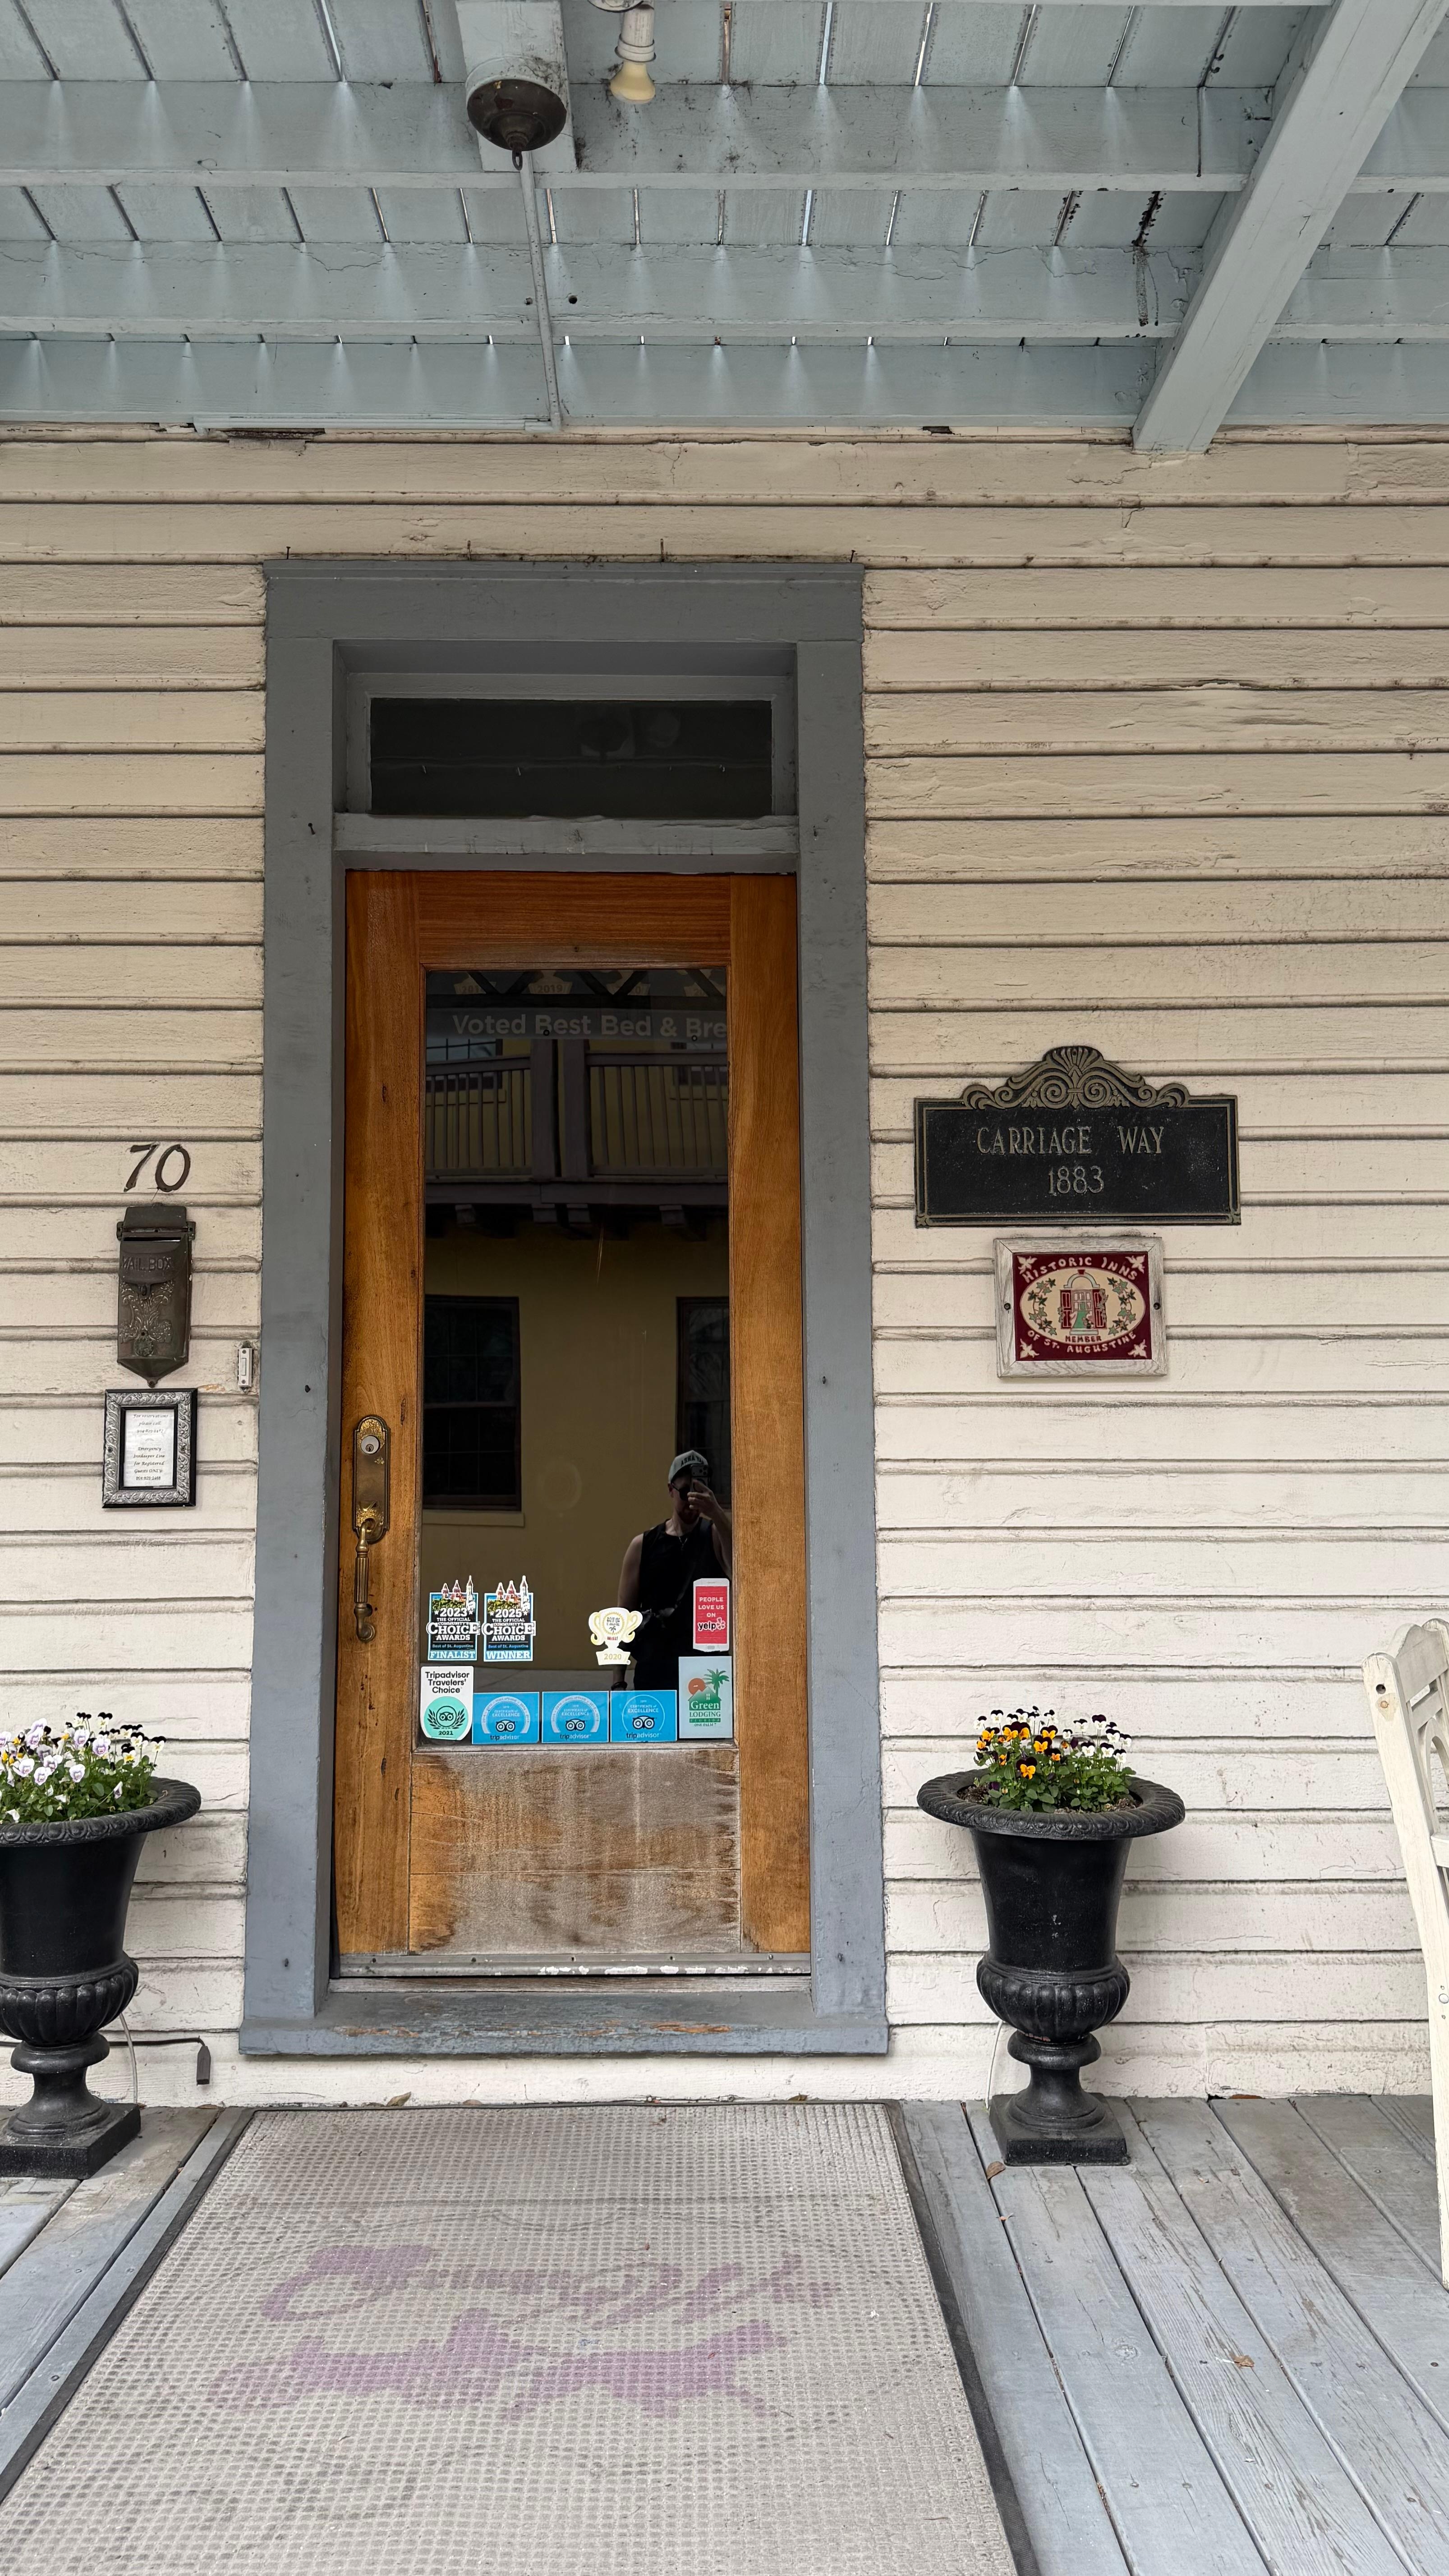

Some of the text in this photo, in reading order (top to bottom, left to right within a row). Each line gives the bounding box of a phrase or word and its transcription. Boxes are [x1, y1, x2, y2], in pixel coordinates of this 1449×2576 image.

[537, 984, 563, 994] 2019
[452, 1014, 526, 1035] Voted
[535, 1014, 592, 1035] Best
[601, 1015, 652, 1036] Bed
[660, 1017, 677, 1037] &
[977, 1126, 1164, 1155] CARRIAGE WAY
[124, 1143, 191, 1192] 70
[1048, 1165, 1105, 1194] 1883
[148, 1256, 172, 1270] BOX
[1021, 1256, 1138, 1283] HISTORIC INNS
[1027, 1330, 1136, 1353] OF ST. AUGUSTINE
[1065, 1335, 1102, 1343] MEMBER
[440, 1607, 468, 1617] 2023
[495, 1608, 522, 1618] 2025
[428, 1622, 480, 1634] CHOICE
[483, 1622, 534, 1635] CHOICE
[698, 1621, 716, 1631] yelp
[430, 1651, 476, 1659] FINALIST
[486, 1650, 530, 1659] WINNER
[425, 1671, 470, 1680] Tripadvisor
[428, 1678, 467, 1686] Travelers'
[690, 1700, 720, 1710] Green
[626, 1732, 660, 1740] tripadvisor
